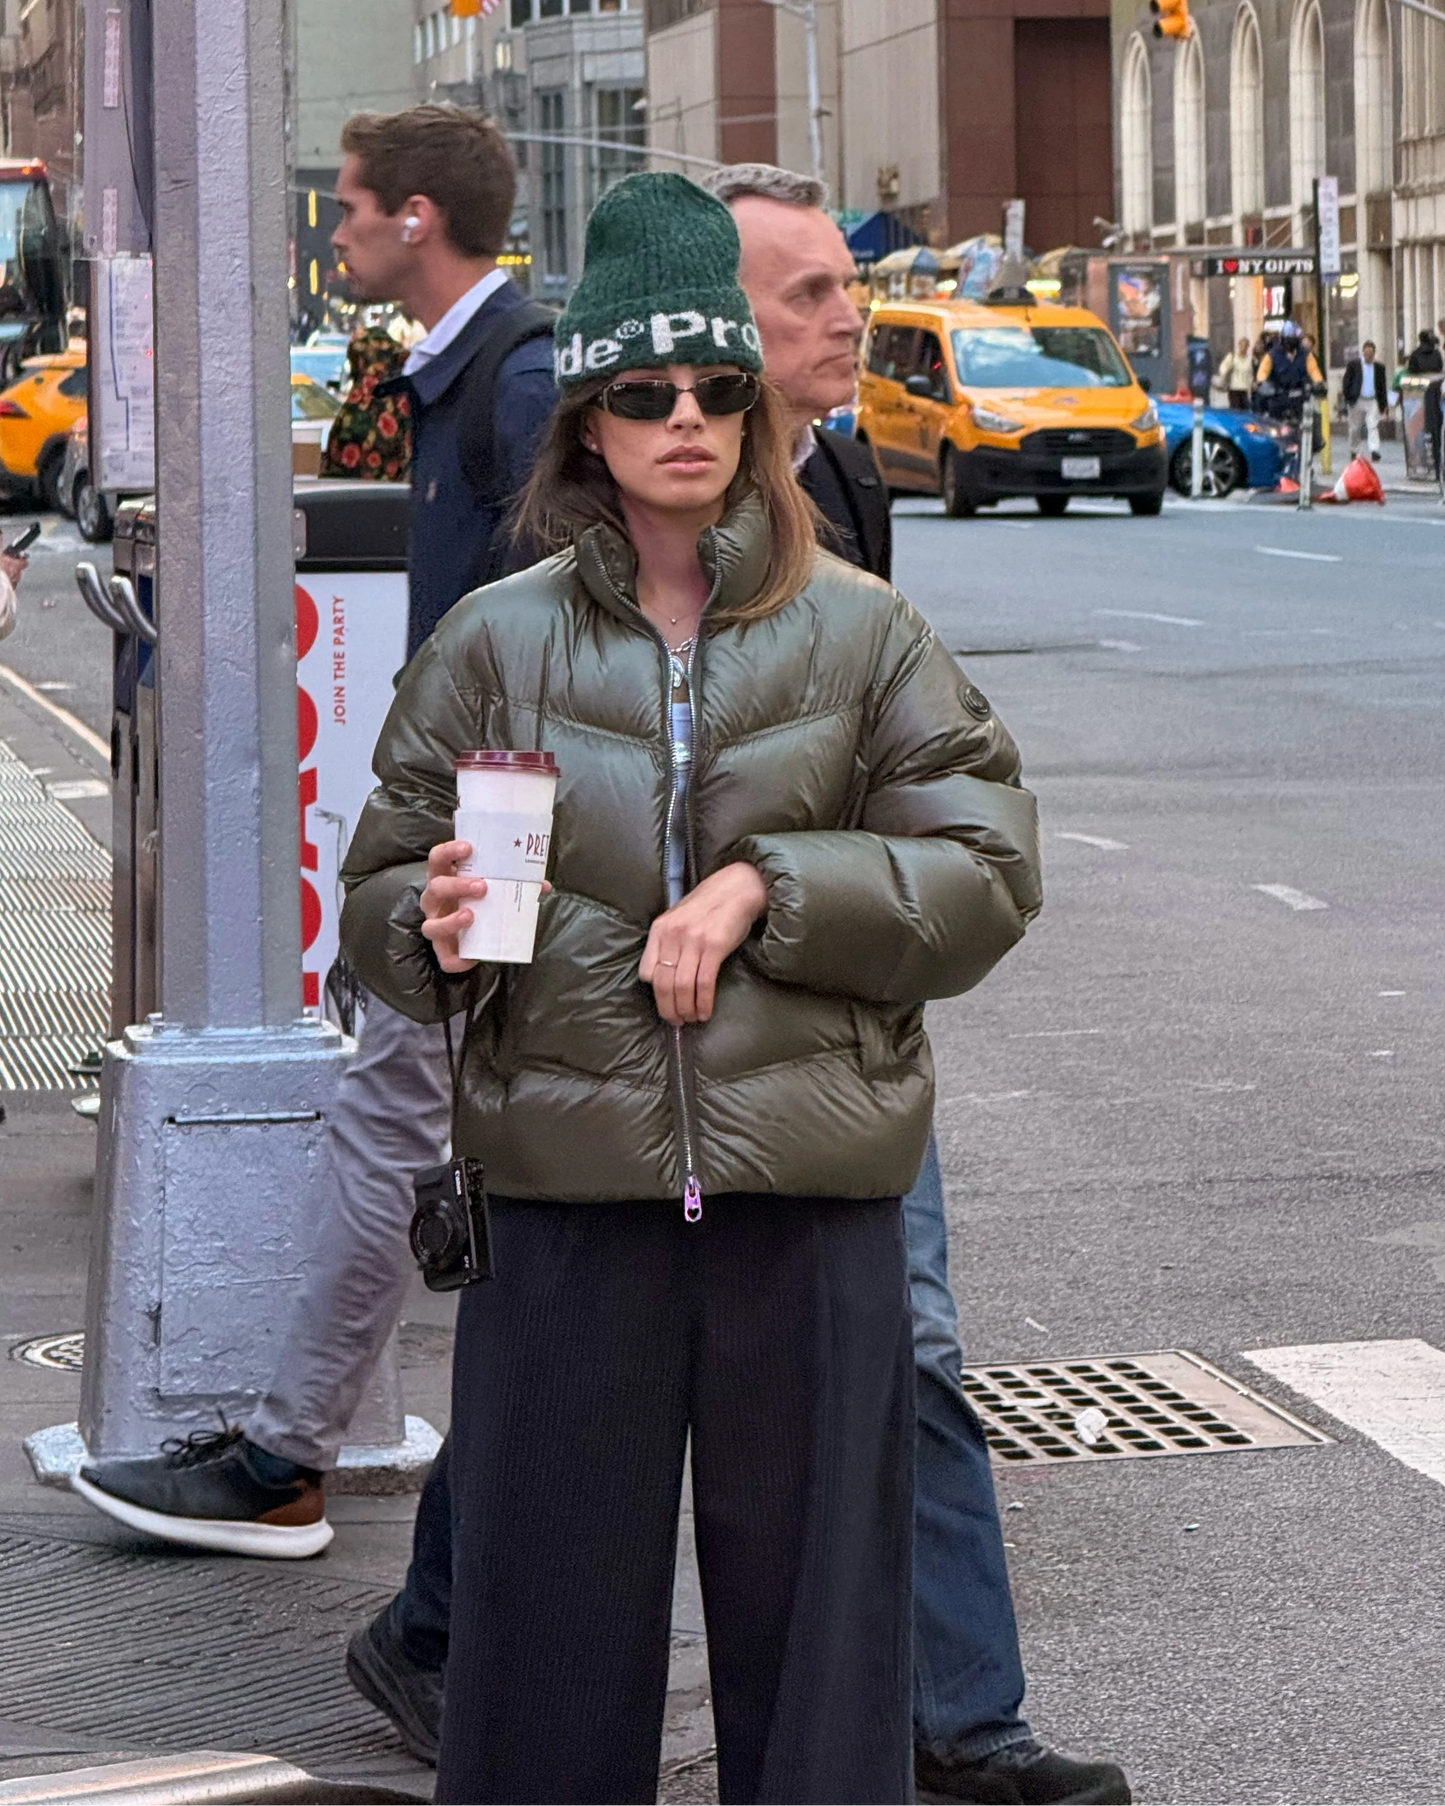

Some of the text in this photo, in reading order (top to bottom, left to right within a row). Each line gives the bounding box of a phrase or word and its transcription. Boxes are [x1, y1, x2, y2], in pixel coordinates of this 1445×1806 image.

[1216, 258, 1224, 274] I
[1238, 258, 1263, 274] NY
[332, 595, 345, 725] JOIN THE PARTY
